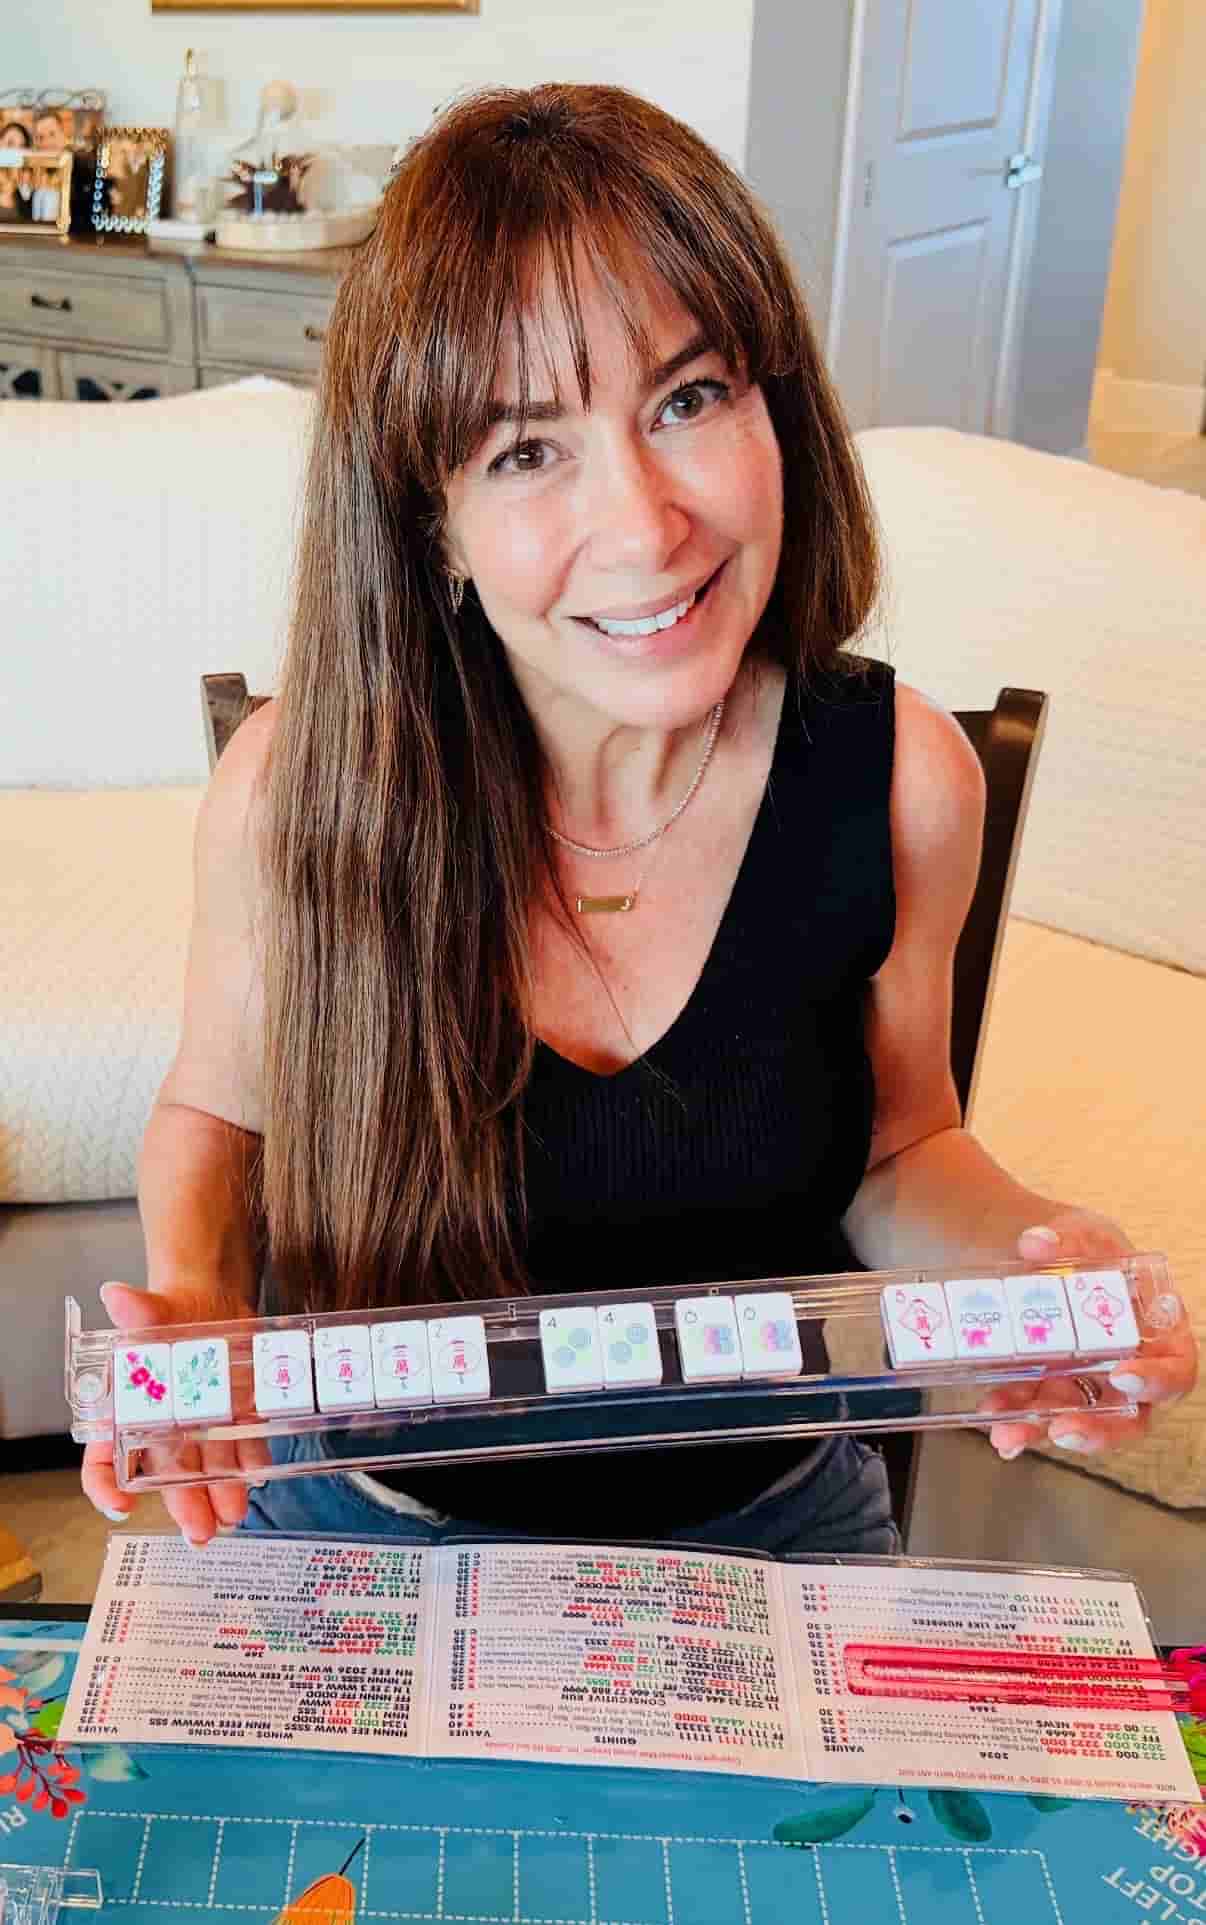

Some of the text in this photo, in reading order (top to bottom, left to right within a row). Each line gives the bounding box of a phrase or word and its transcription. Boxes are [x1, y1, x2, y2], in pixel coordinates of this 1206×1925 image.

[912, 1618, 962, 1627] NUMBERS
[594, 1736, 637, 1745] QUINTS
[824, 1744, 864, 1752] VALUES
[1149, 1865, 1206, 1912] TOP
